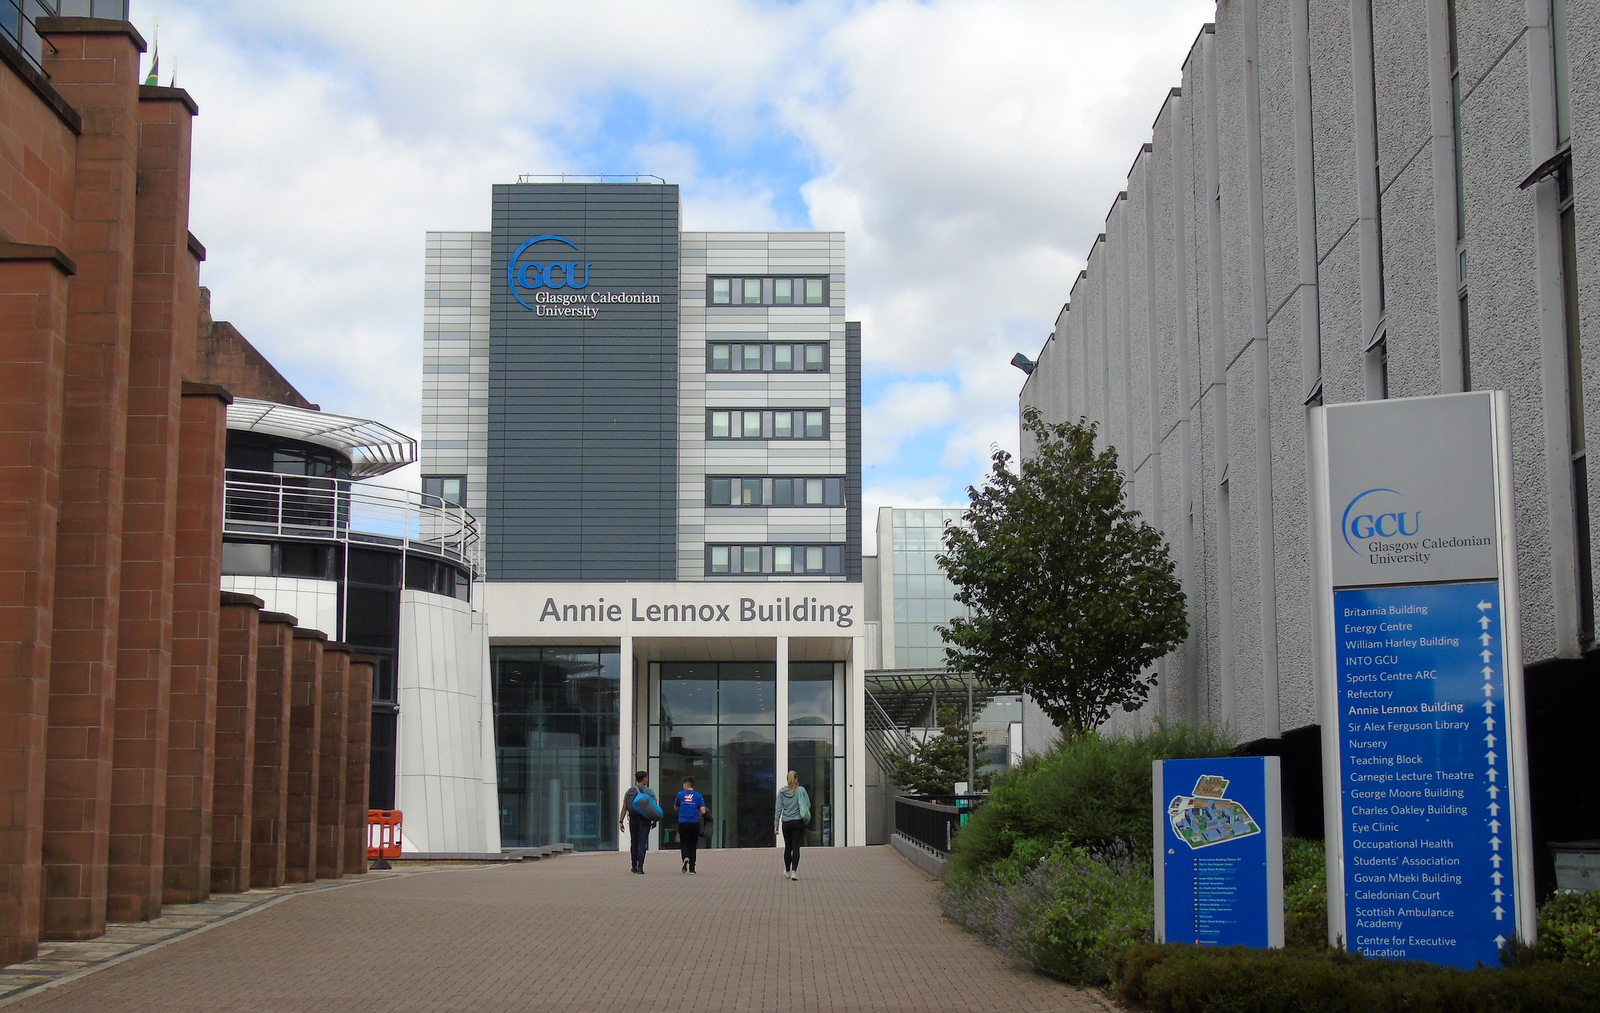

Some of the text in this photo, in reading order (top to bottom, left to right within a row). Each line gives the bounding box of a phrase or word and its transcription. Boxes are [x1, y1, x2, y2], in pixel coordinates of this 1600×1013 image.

[517, 262, 592, 289] GCU
[535, 292, 660, 306] Glasgow Caledonian
[536, 305, 599, 319] University
[1351, 511, 1421, 539] GCU
[1368, 536, 1491, 553] Glasgow Caledonian
[1369, 552, 1430, 564] University
[539, 596, 854, 628] Annie Lennox Building
[1344, 605, 1428, 617] Britannia Building
[1345, 622, 1412, 634] Energy Centre
[1346, 637, 1459, 649] William Harley Building
[1346, 655, 1398, 665] INTO GCU
[1347, 670, 1438, 683] Sports Centre ARC
[1348, 689, 1393, 699] Refectory
[1348, 702, 1463, 715] Annie Lennox Building
[1349, 721, 1469, 732] Sir Alex Ferguson Library
[1349, 739, 1387, 749] Nursery
[1350, 754, 1422, 766] Teaching Block
[1350, 770, 1474, 783] Carnegie Lecture Theatre
[1351, 788, 1464, 800] George Moore Building
[1352, 804, 1468, 816] Charles Oakley Building
[1352, 822, 1399, 833] Eye Clinic
[1353, 839, 1453, 850] Occupational Health
[1402, 856, 1460, 865] Association
[1354, 873, 1462, 884] Govan Mbeki Building
[1355, 890, 1440, 900] Caledonian Court
[1355, 907, 1454, 917] Scottish Ambulance
[1356, 918, 1402, 929] Academy
[1357, 935, 1456, 946] Centre for Executive
